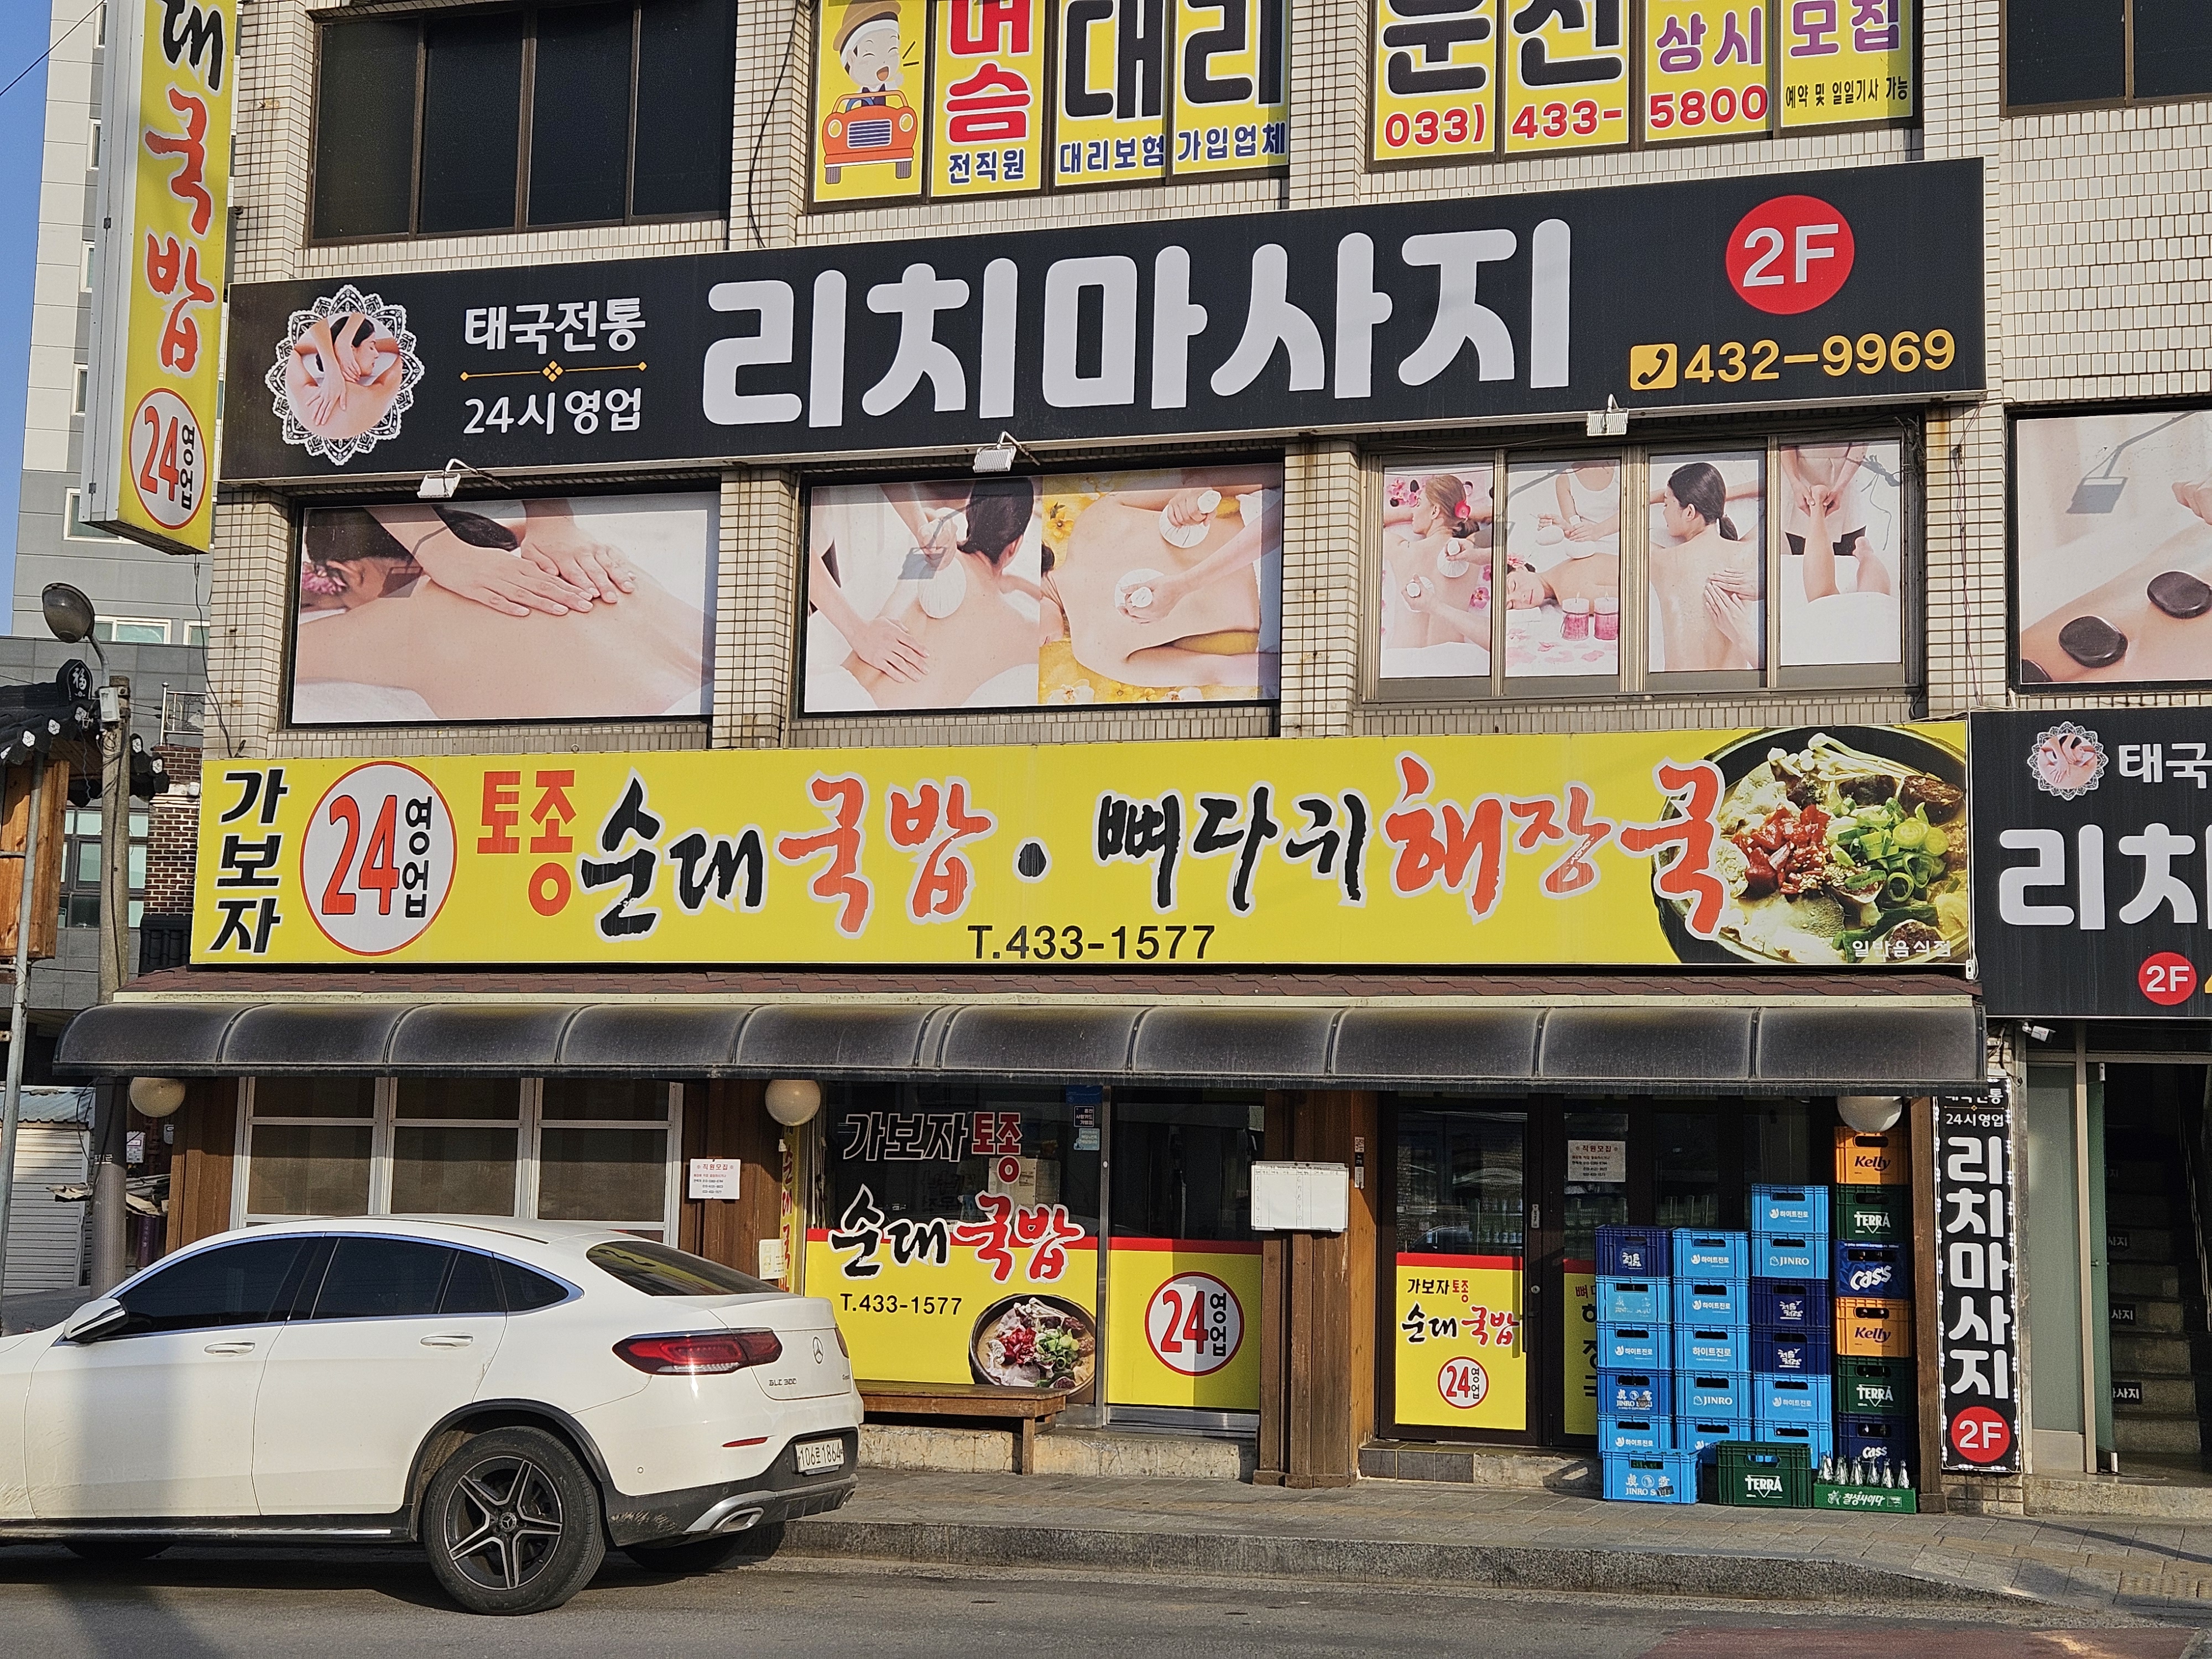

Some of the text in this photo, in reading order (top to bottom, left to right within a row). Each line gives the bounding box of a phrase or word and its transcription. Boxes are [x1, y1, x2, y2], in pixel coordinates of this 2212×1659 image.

[1657, 0, 1899, 72] 상시 모집
[1786, 76, 1908, 109] 예약 및 일일기사 가능
[1385, 85, 1768, 147] 033) 433- 5800
[950, 148, 1024, 185] 전직원
[1743, 223, 1839, 287] 2F
[464, 297, 646, 354] 태국전통
[702, 218, 1571, 428] 리치마사지
[1684, 328, 1955, 383] 432-9969
[141, 405, 195, 512] 24 영업
[321, 795, 432, 918] 24 영업
[477, 770, 577, 916] 토종
[209, 769, 288, 953] 가보자
[968, 925, 1215, 961] T.433-1577
[1853, 940, 1951, 958] 일반음식점
[2146, 966, 2190, 992] 2F
[843, 1112, 1023, 1183] 가보자 토종
[1854, 1156, 1891, 1171] Kelly
[1854, 1211, 1891, 1228] TERRA
[1701, 1255, 1730, 1264] 하이트진로
[1780, 1256, 1810, 1266] JINRO
[1945, 1136, 2011, 1399] 리치마사지
[840, 1293, 962, 1316] T.433-1577
[1407, 1279, 1469, 1303] 가보자 토종
[1702, 1301, 1731, 1310] 하이트진로
[1161, 1289, 1227, 1357] 24 영업
[1854, 1327, 1891, 1343] Kelly
[1692, 1347, 1732, 1357] 하이트진로
[1446, 1365, 1480, 1400] 24 영업
[1856, 1384, 1894, 1401] TERRA
[2112, 1388, 2140, 1399] 사지
[1703, 1396, 1733, 1406] JINRO
[1625, 1438, 1653, 1447] 하이트진로
[1959, 1420, 2003, 1449] 2F
[1625, 1488, 1648, 1496] JINRO
[1744, 1474, 1783, 1492] TERRA
[1842, 1491, 1886, 1506] 칠성사이다
